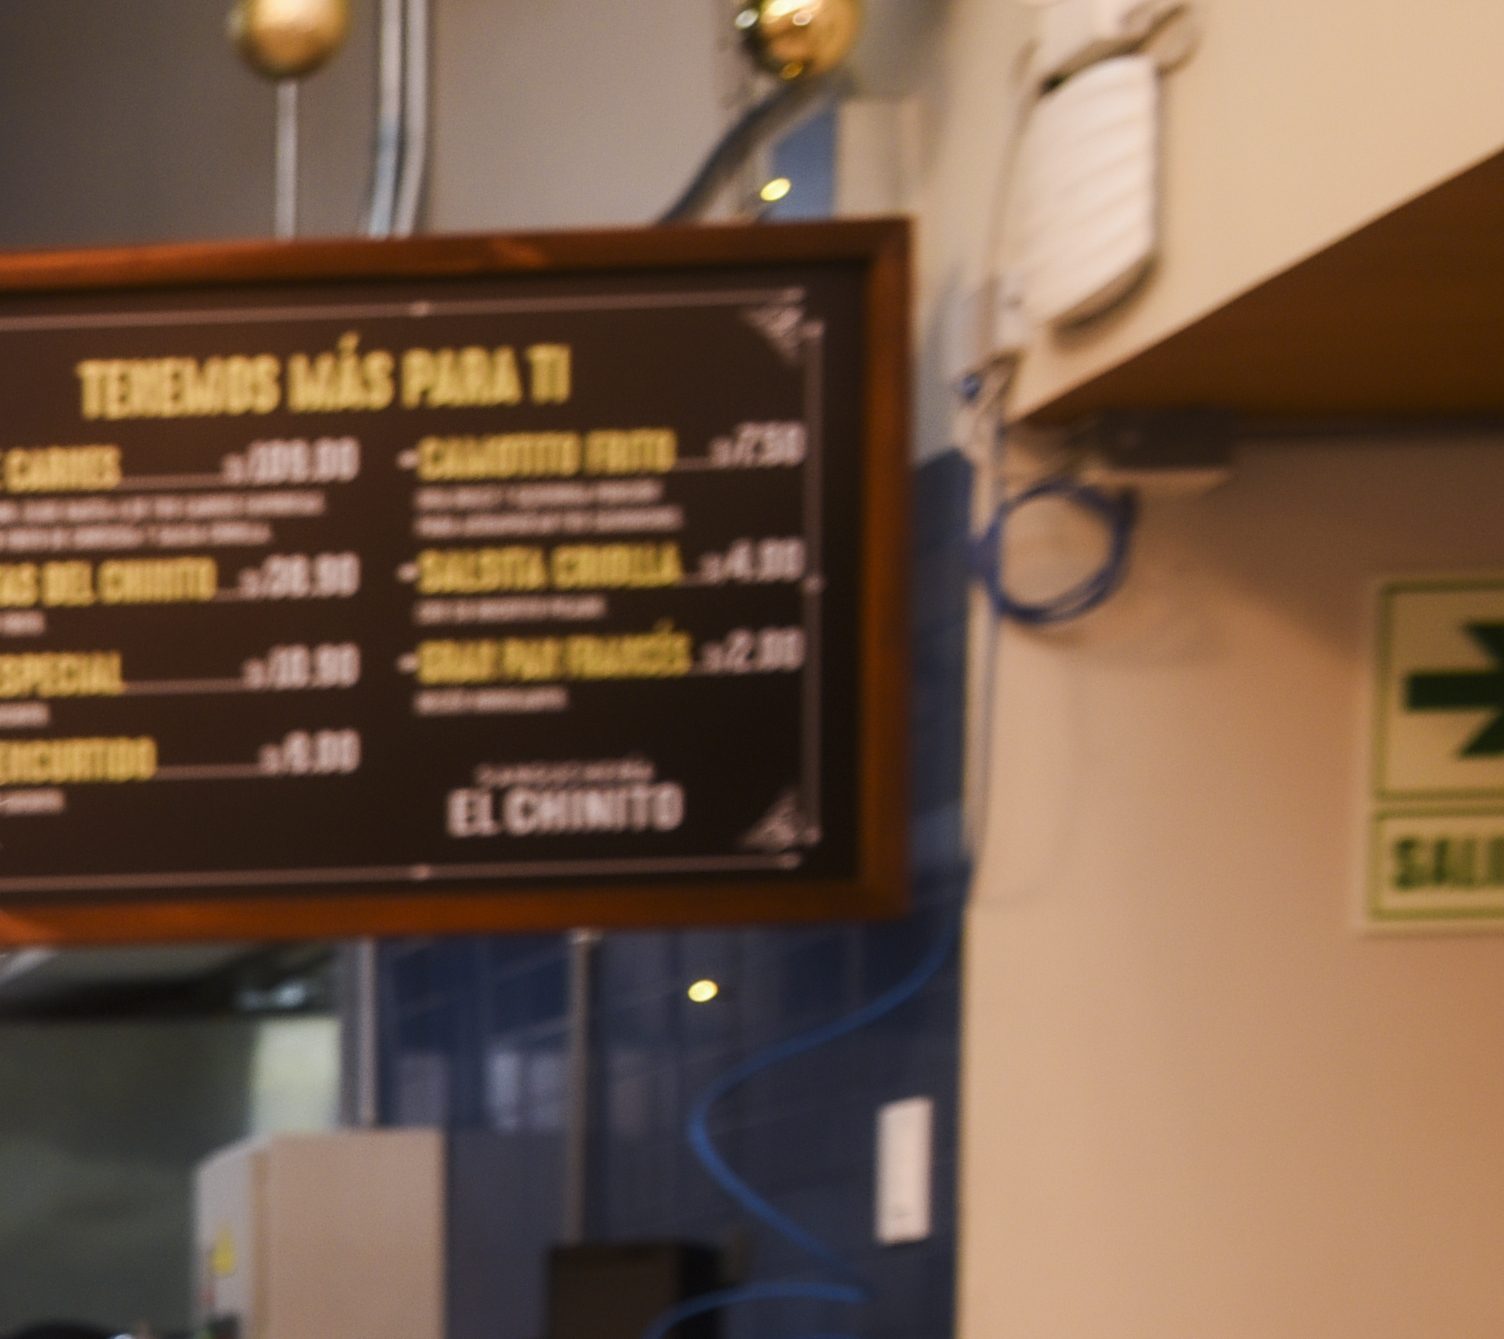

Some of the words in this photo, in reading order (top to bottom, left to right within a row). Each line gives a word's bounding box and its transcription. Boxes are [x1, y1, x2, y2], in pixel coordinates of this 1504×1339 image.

[78, 356, 279, 420] TENEMOS
[290, 333, 393, 412] MÁS
[403, 348, 519, 407] PARA
[528, 345, 571, 402] TI
[504, 781, 682, 832] CHINITO
